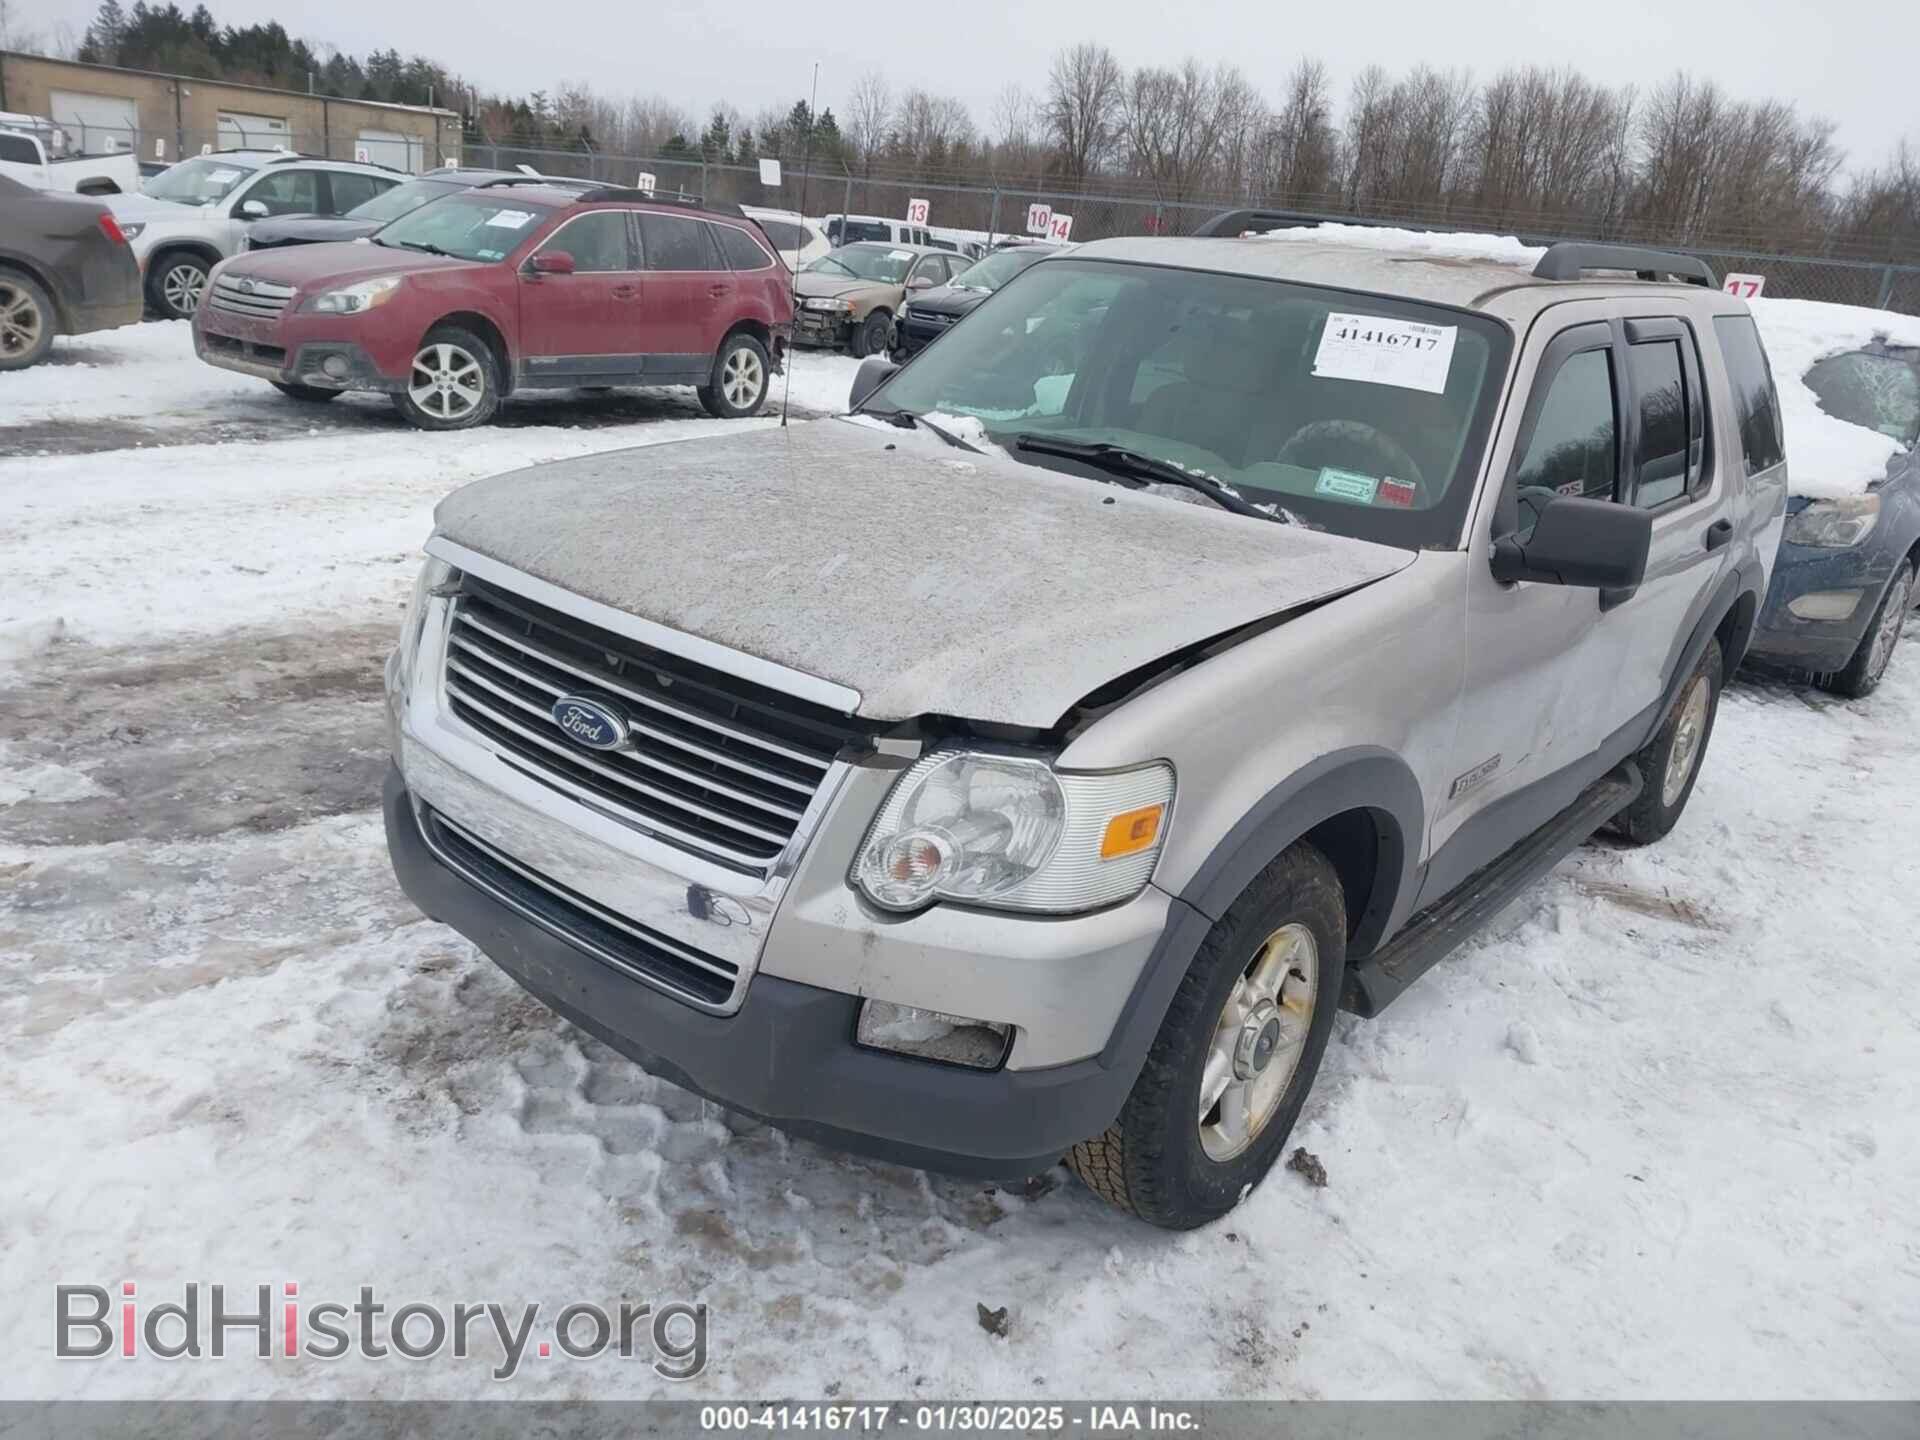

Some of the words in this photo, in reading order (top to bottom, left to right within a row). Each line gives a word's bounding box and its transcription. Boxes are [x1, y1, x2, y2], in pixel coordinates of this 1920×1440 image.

[910, 204, 926, 222] 13
[1030, 211, 1048, 228] 10
[1051, 219, 1068, 239] 14
[1728, 281, 1759, 298] 17
[1336, 328, 1438, 351] 41416717
[562, 706, 603, 741] Ford
